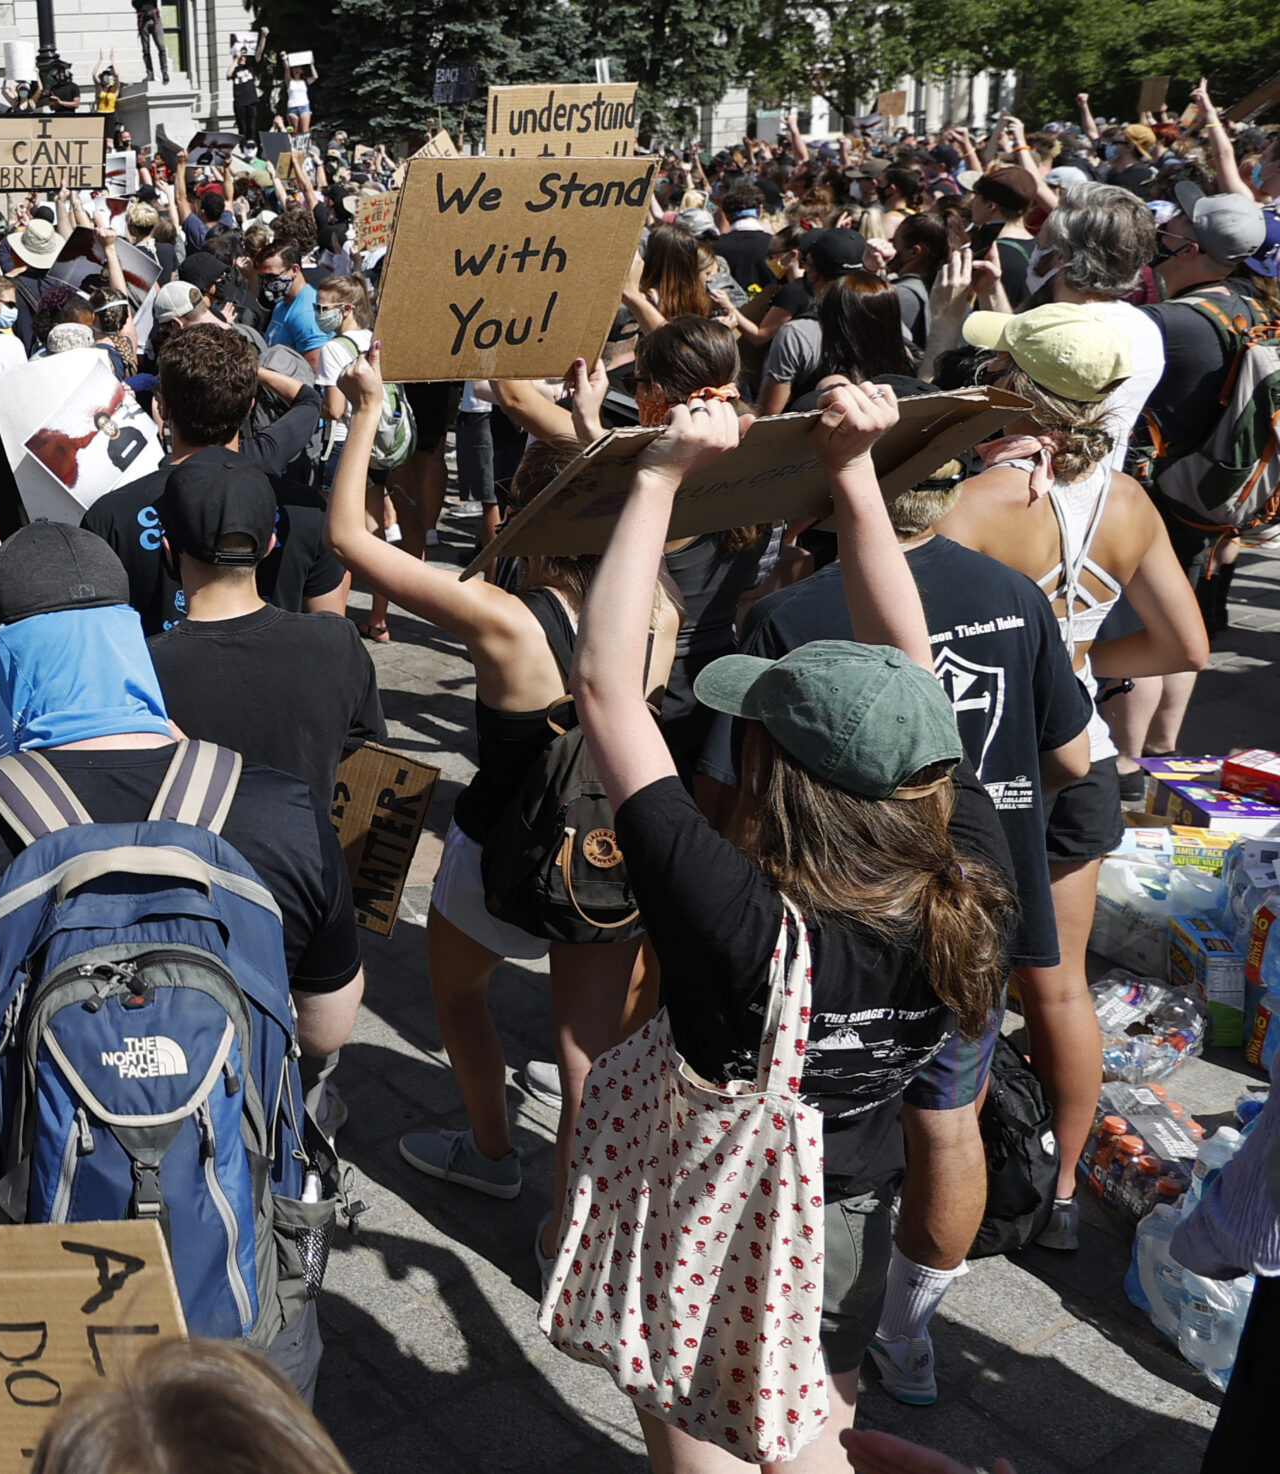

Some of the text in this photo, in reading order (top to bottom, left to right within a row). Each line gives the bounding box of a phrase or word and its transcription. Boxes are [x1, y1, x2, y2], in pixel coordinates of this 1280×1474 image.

[491, 95, 498, 134] I
[509, 90, 638, 135] understand
[37, 118, 52, 139] I
[12, 140, 89, 165] CANT
[0, 165, 92, 188] BREATHE
[436, 163, 655, 214] We Stand
[454, 235, 567, 276] with
[449, 291, 558, 356] You!
[954, 621, 997, 639] Ticket
[123, 1036, 156, 1052] THE
[101, 1050, 158, 1067] NORTH
[118, 1063, 160, 1079] FACE
